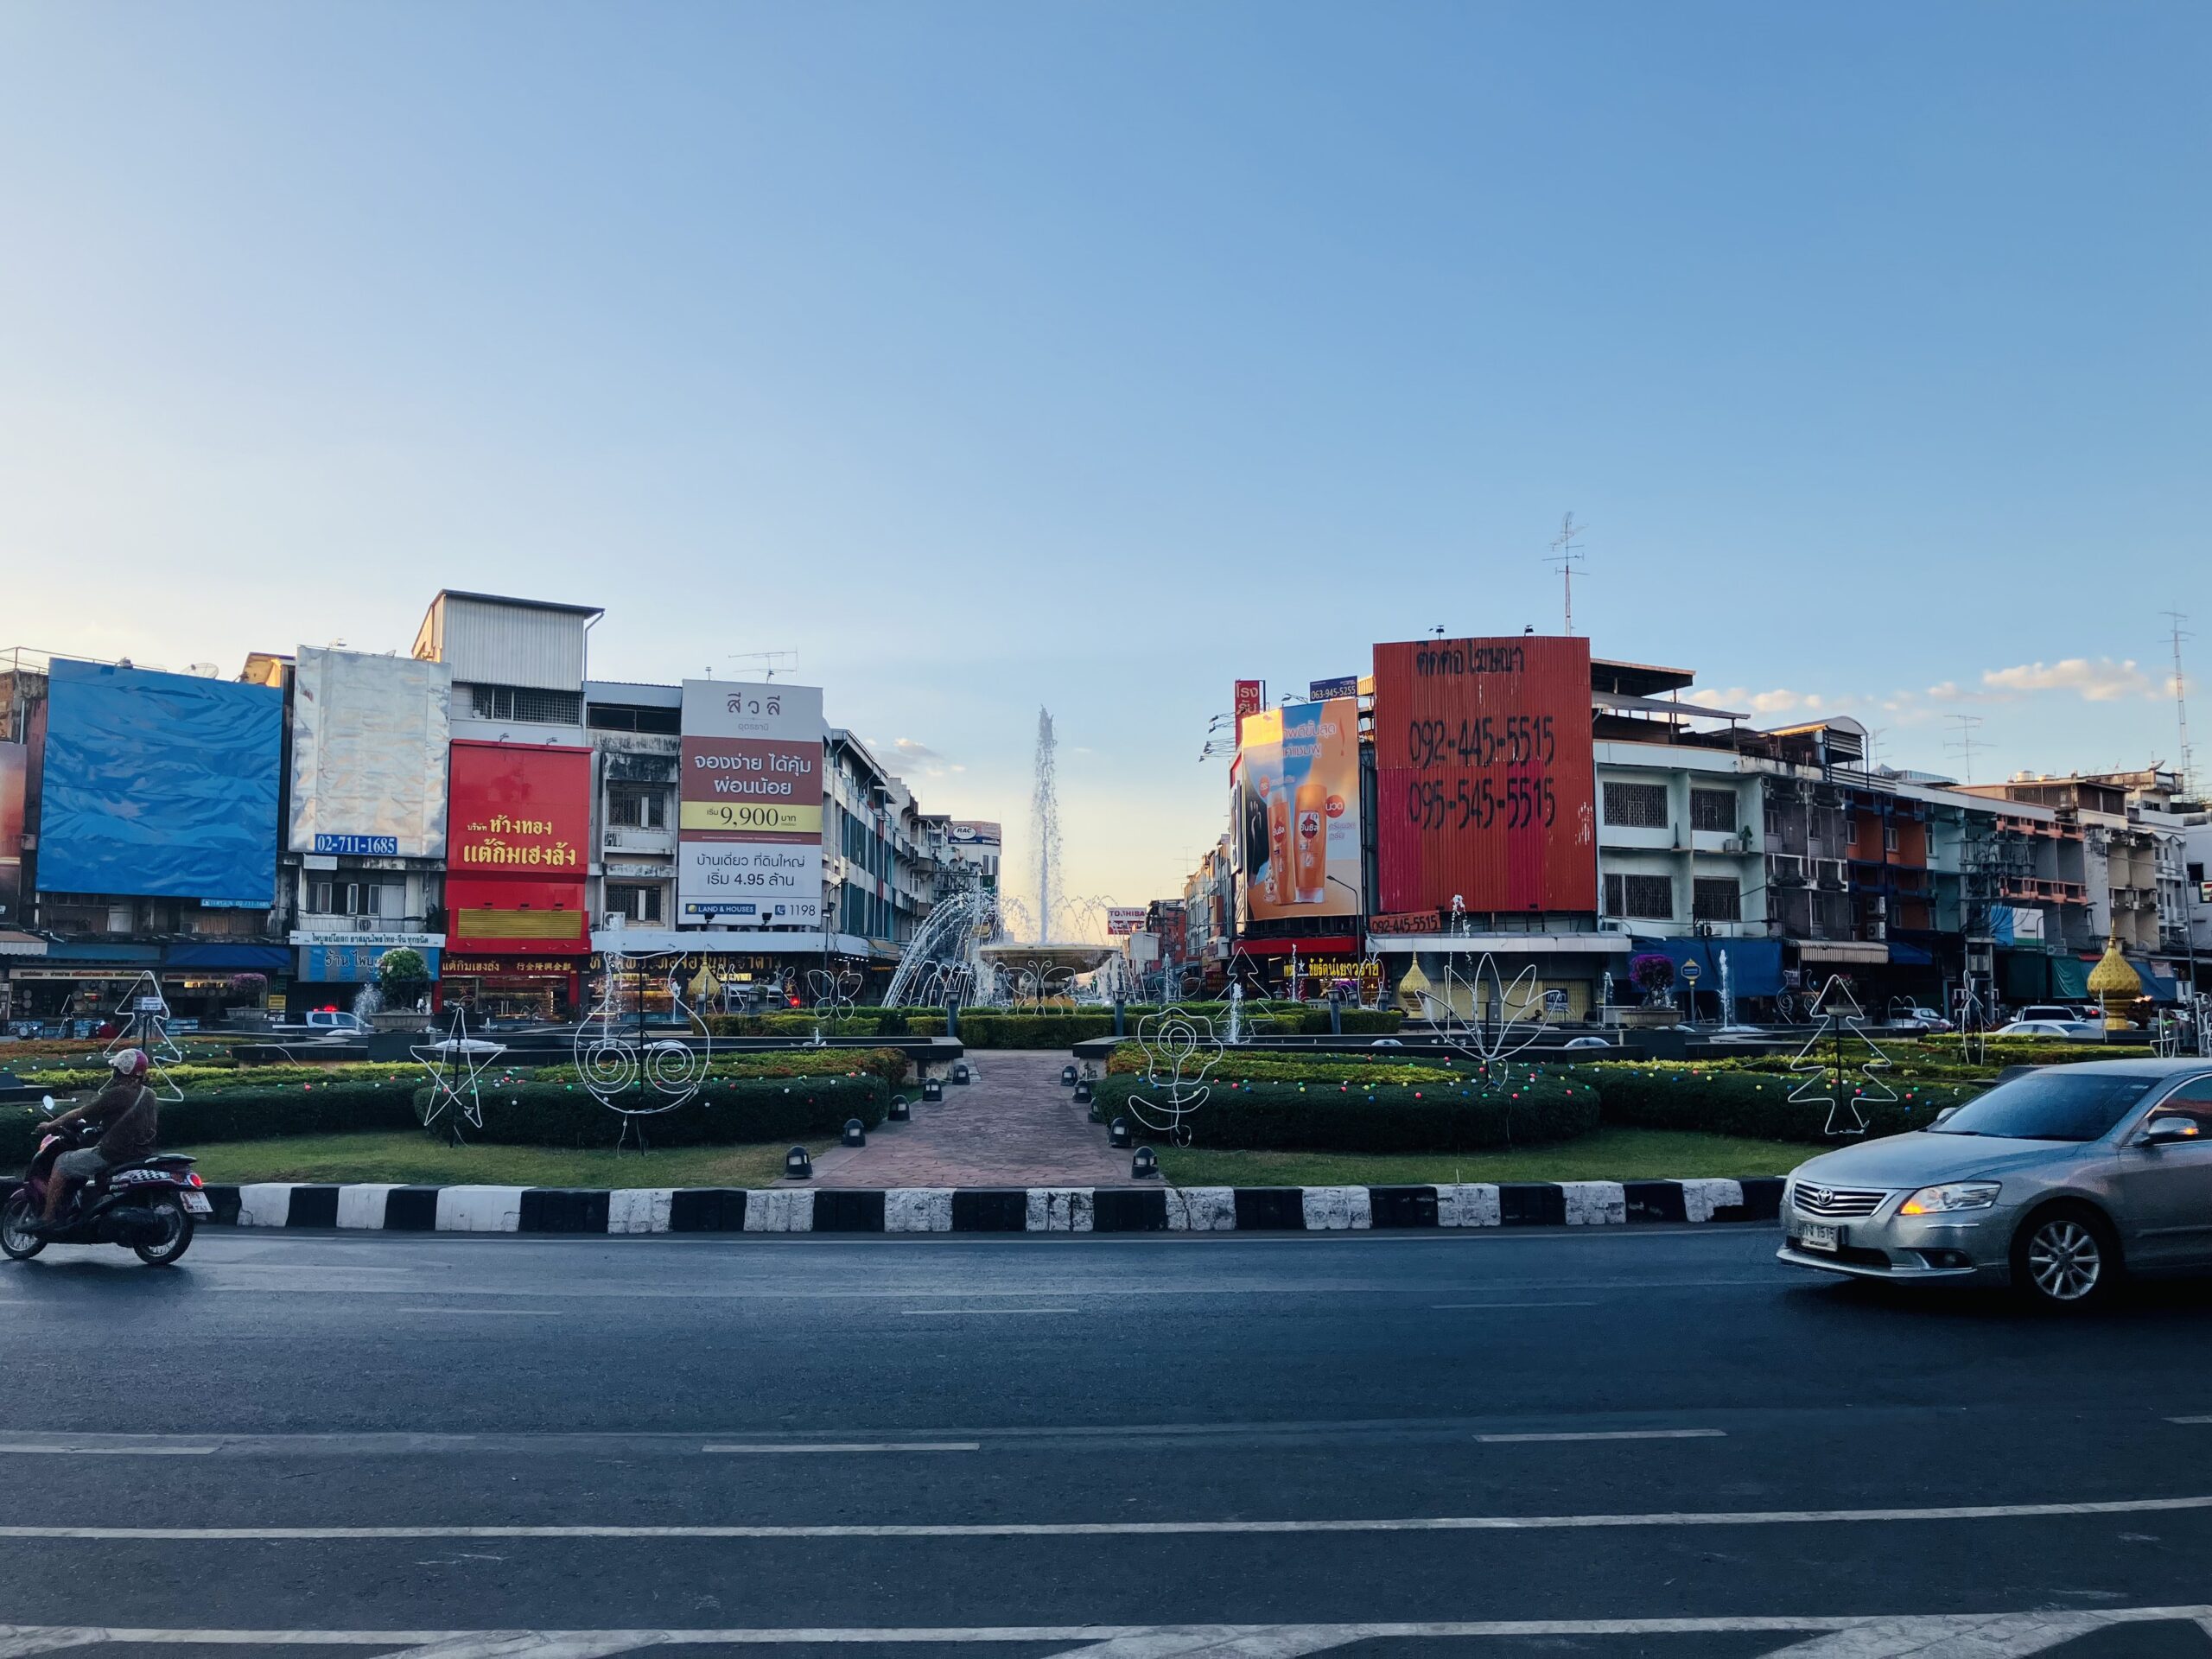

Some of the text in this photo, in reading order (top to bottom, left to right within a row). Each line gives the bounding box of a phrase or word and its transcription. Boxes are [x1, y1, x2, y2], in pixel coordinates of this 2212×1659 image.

[1236, 683, 1259, 698] โรง
[1311, 685, 1356, 699] 063-945-5255
[695, 753, 811, 777] จองง่าย ได้คุ้ม
[714, 776, 791, 795] ผ่อนน้อย
[1325, 802, 1343, 811] นวด
[489, 814, 552, 836] ห้างทอง
[707, 806, 718, 815] เริ่ม
[721, 806, 779, 828] 9,900
[317, 836, 395, 853] 02-711-1685
[463, 838, 576, 866] แต้กิมเฮงล้ง
[697, 851, 805, 868] บ้านเดี่ยว ที่ดินใหญ่
[707, 868, 794, 886] เริ่ม 4.95 ล้าน
[790, 905, 816, 916] 1198
[1372, 915, 1438, 934] 092-445-5515
[325, 949, 350, 967] ร้าน
